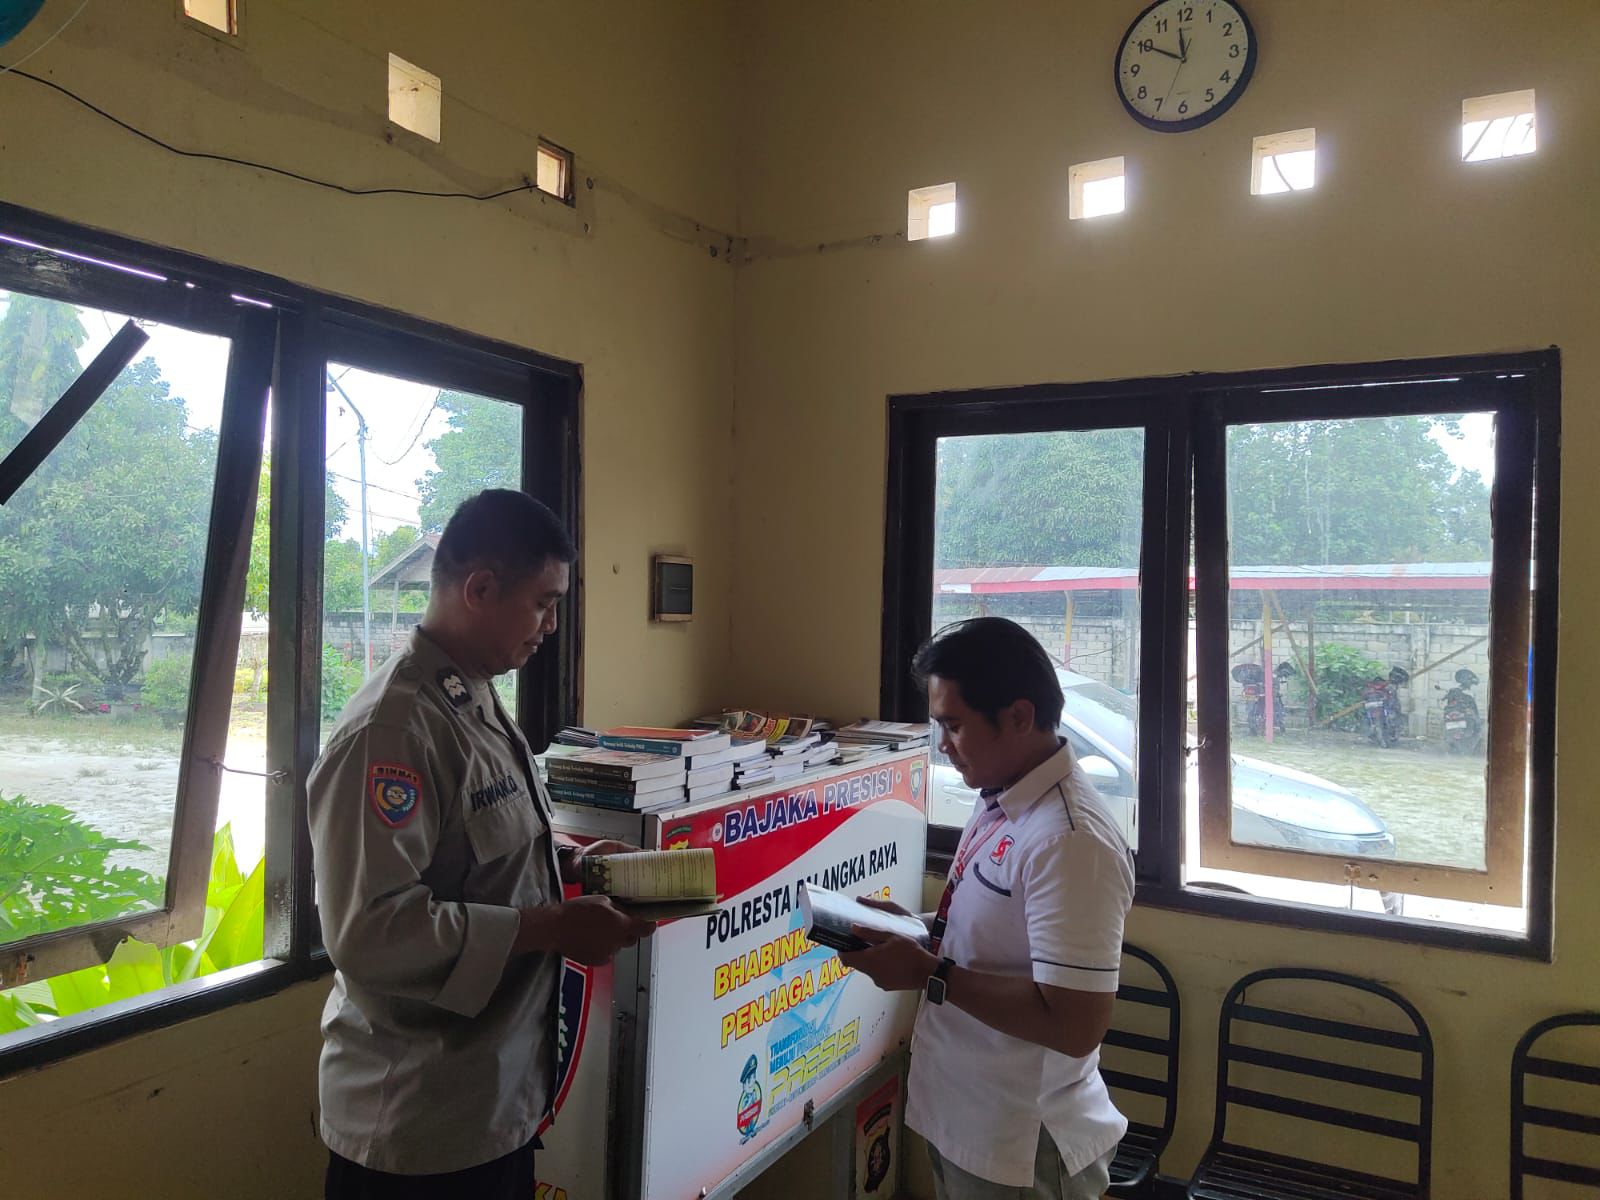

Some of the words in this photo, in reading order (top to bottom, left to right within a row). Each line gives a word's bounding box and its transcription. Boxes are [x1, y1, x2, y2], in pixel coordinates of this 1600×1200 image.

[1177, 7, 1193, 23] 12
[1206, 10, 1212, 23] 1
[1155, 19, 1168, 34] 11
[1222, 22, 1232, 37] 2
[1137, 39, 1154, 54] 10
[1229, 44, 1240, 58] 3
[1130, 64, 1141, 78] 9
[1219, 69, 1231, 84] 4
[1137, 86, 1147, 100] 8
[1204, 88, 1215, 103] 5
[1154, 97, 1163, 112] 7
[1177, 100, 1188, 114] 6
[723, 788, 818, 848] BAJAKA
[823, 767, 893, 815] PRESISI
[706, 882, 792, 949] POLRESTA
[869, 841, 898, 876] RAYA
[721, 970, 815, 1049] PENJAGA
[768, 1016, 861, 1106] PRESISI
